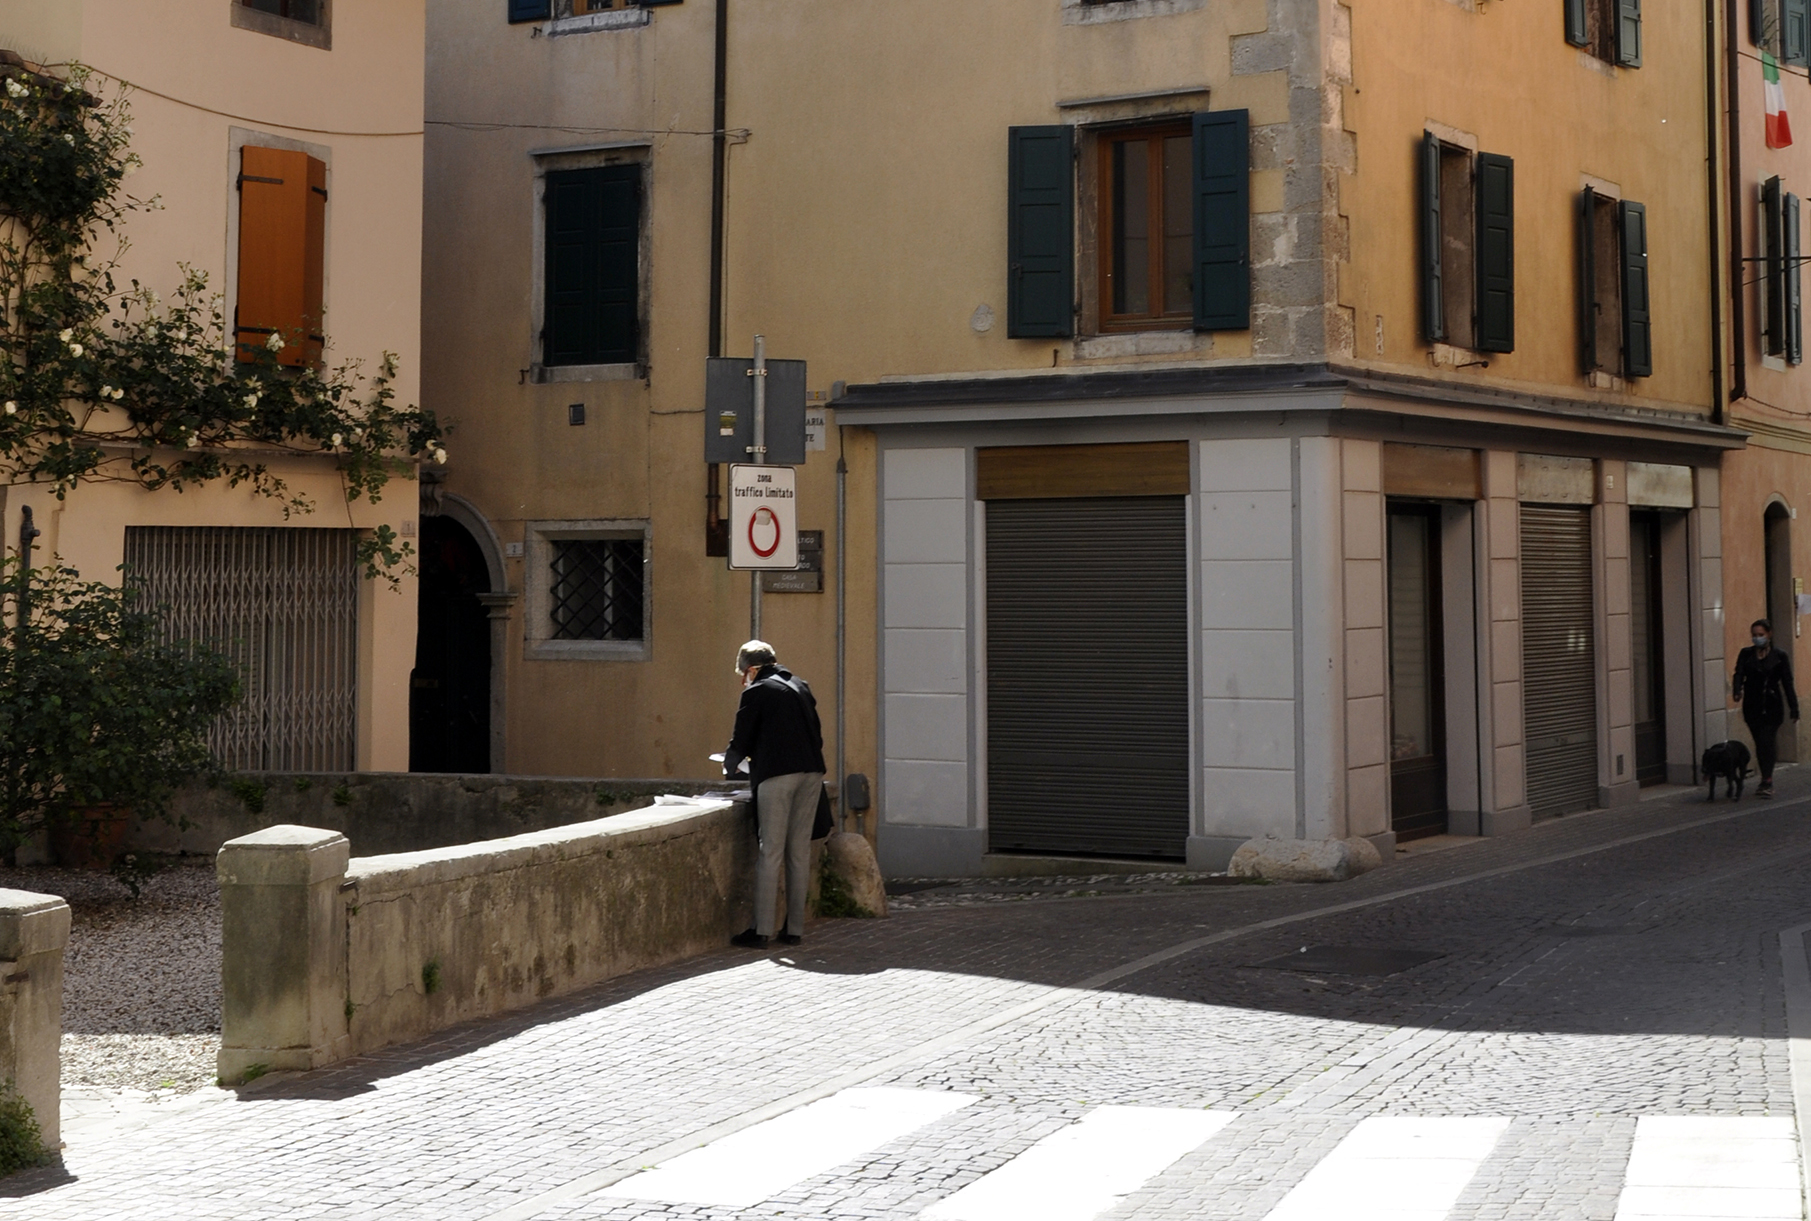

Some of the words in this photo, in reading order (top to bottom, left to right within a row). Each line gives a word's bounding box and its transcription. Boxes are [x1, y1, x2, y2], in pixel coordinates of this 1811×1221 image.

[805, 417, 824, 426] ARIA
[757, 474, 772, 483] zona
[735, 486, 763, 497] traffico
